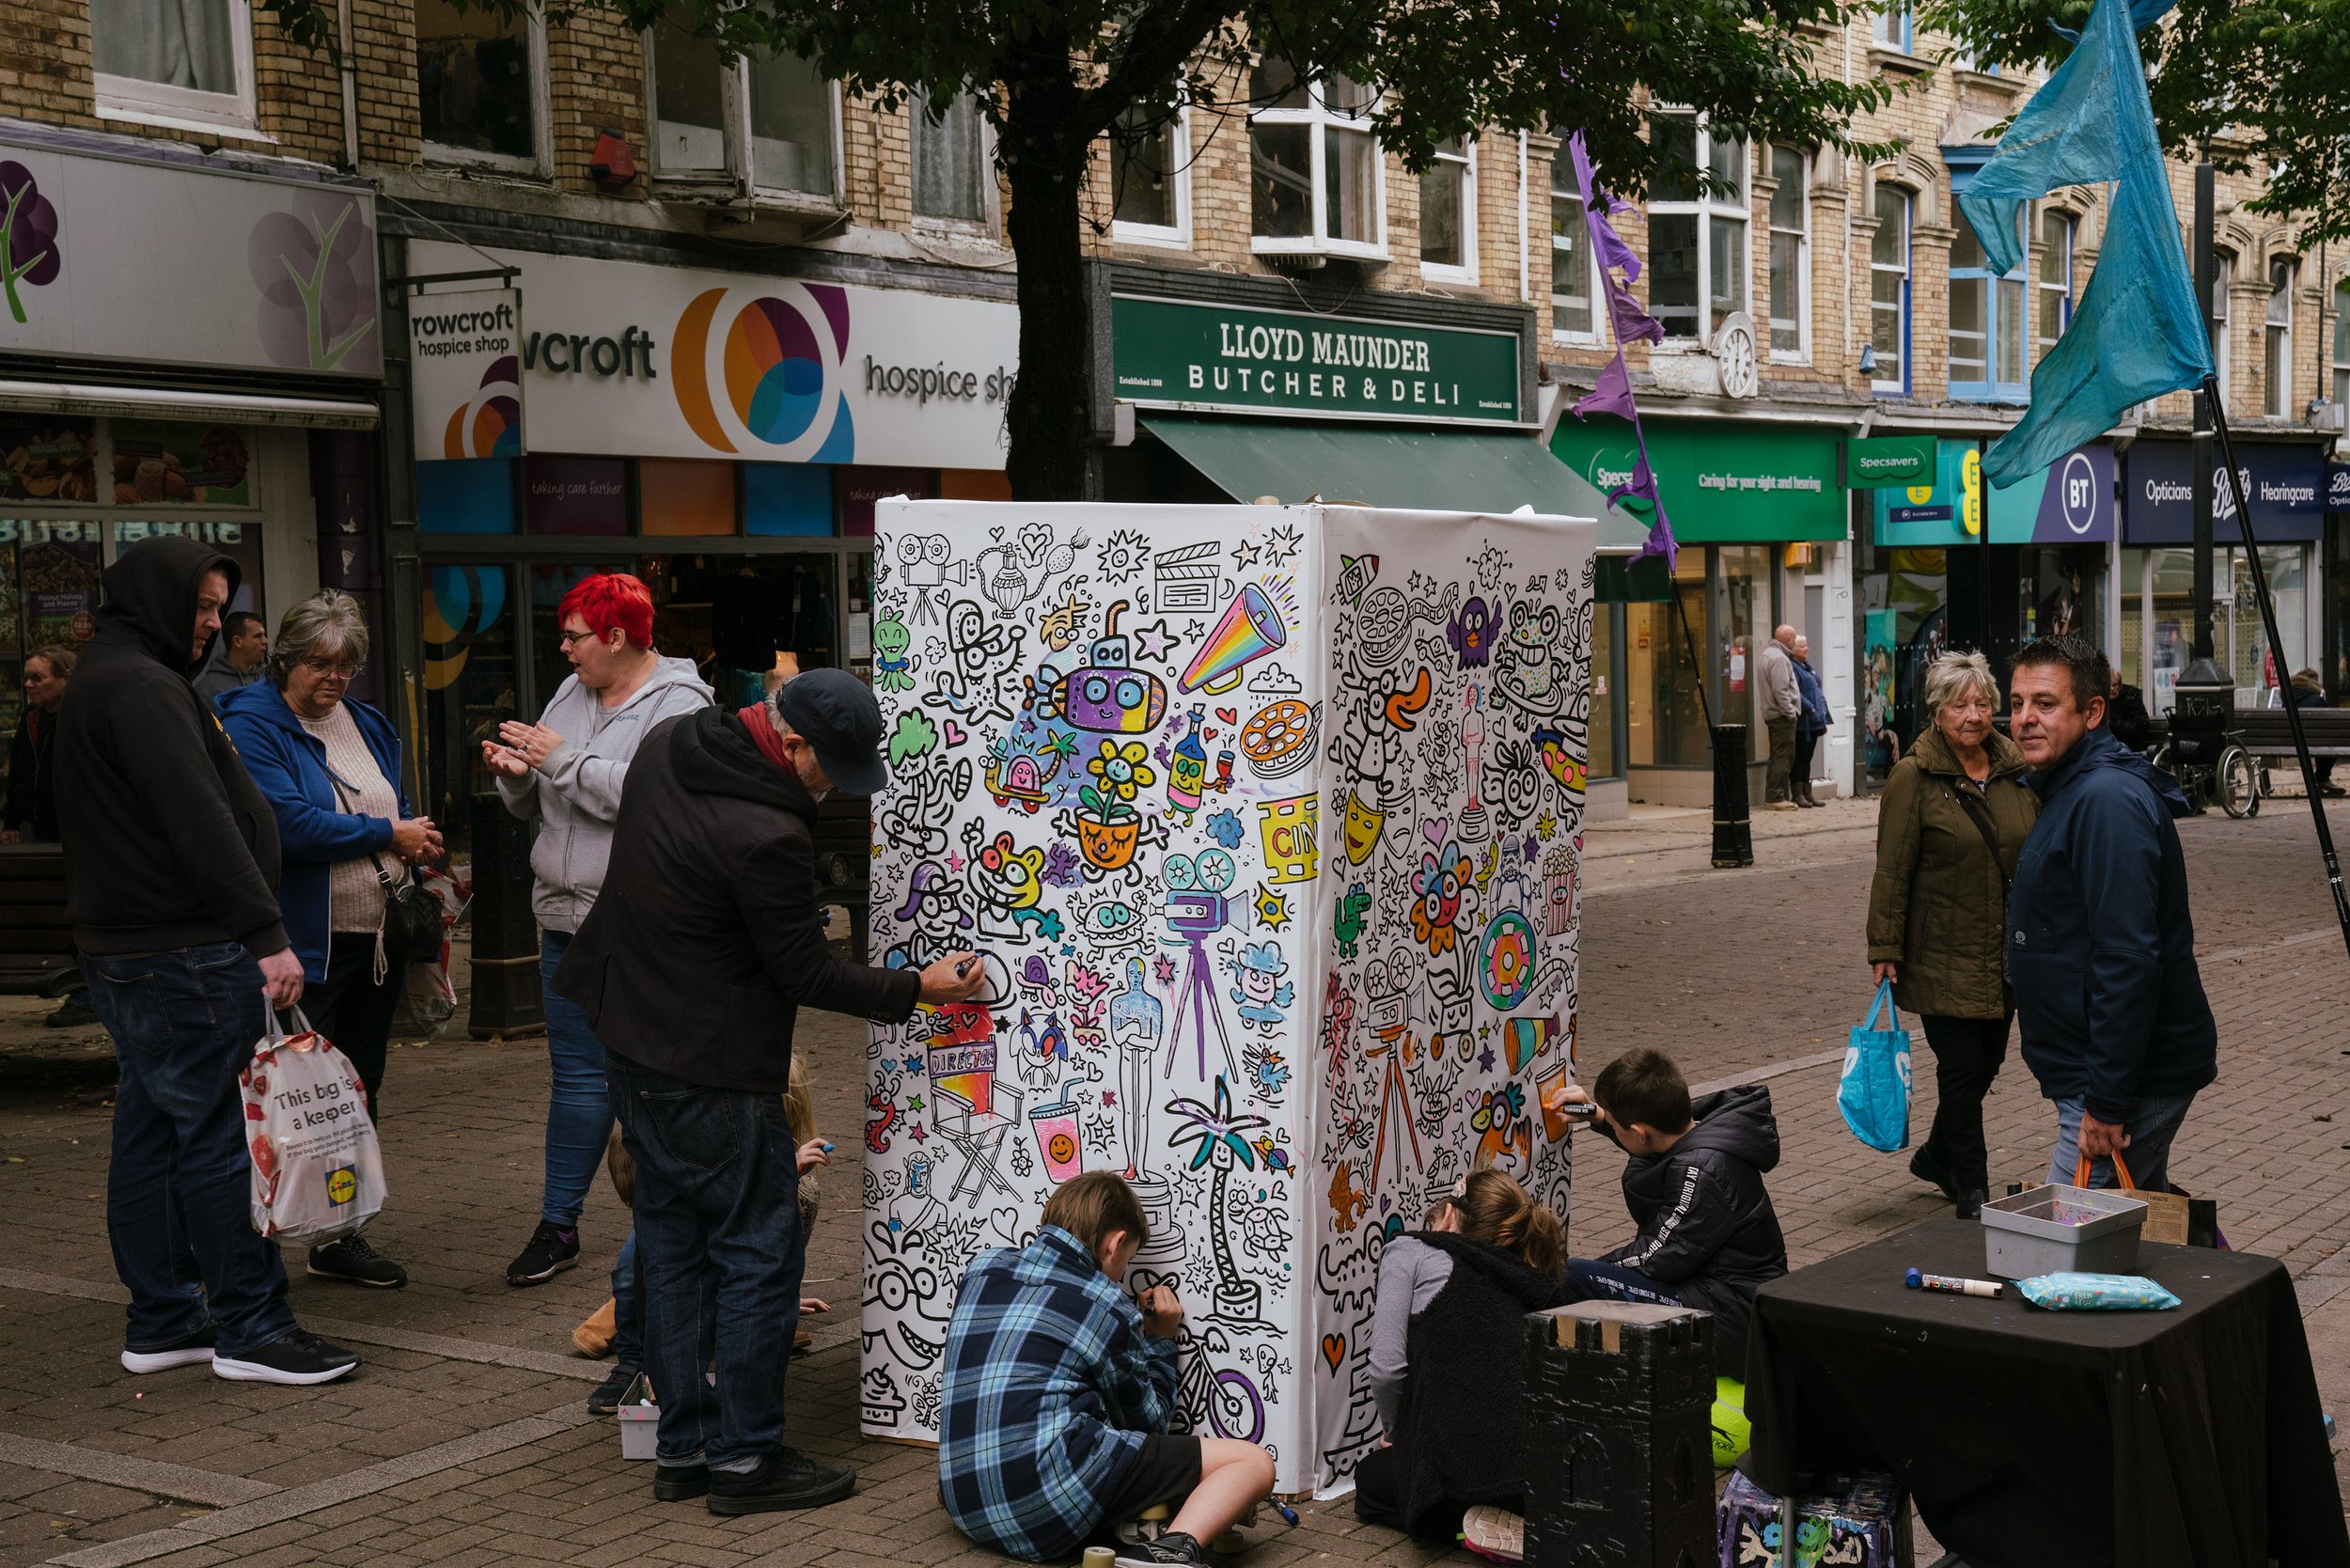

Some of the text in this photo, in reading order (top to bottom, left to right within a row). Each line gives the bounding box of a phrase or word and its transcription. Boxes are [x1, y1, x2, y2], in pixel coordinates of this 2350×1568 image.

[413, 304, 513, 337] rowcroft
[418, 336, 509, 358] hospice shop
[524, 325, 656, 378] croft
[1220, 323, 1430, 372] LLOYD MAUNDER
[866, 354, 1014, 404] hospice sh
[1188, 365, 1459, 405] BUTCHER & DELI
[1860, 457, 1919, 469] Specsavers
[531, 480, 622, 500] taking care further
[1597, 467, 1658, 490] Specsas
[1699, 473, 1821, 493] Caring for your sight and hearing
[2070, 478, 2089, 509] BT
[2146, 479, 2192, 507] Opticians
[2261, 481, 2314, 508] Hearingcare
[2329, 496, 2350, 507] Optic
[932, 1048, 994, 1074] DIRECTOR
[274, 1075, 353, 1110] This bg is
[292, 1101, 356, 1131] a keeper
[1685, 1166, 1699, 1181] TAY
